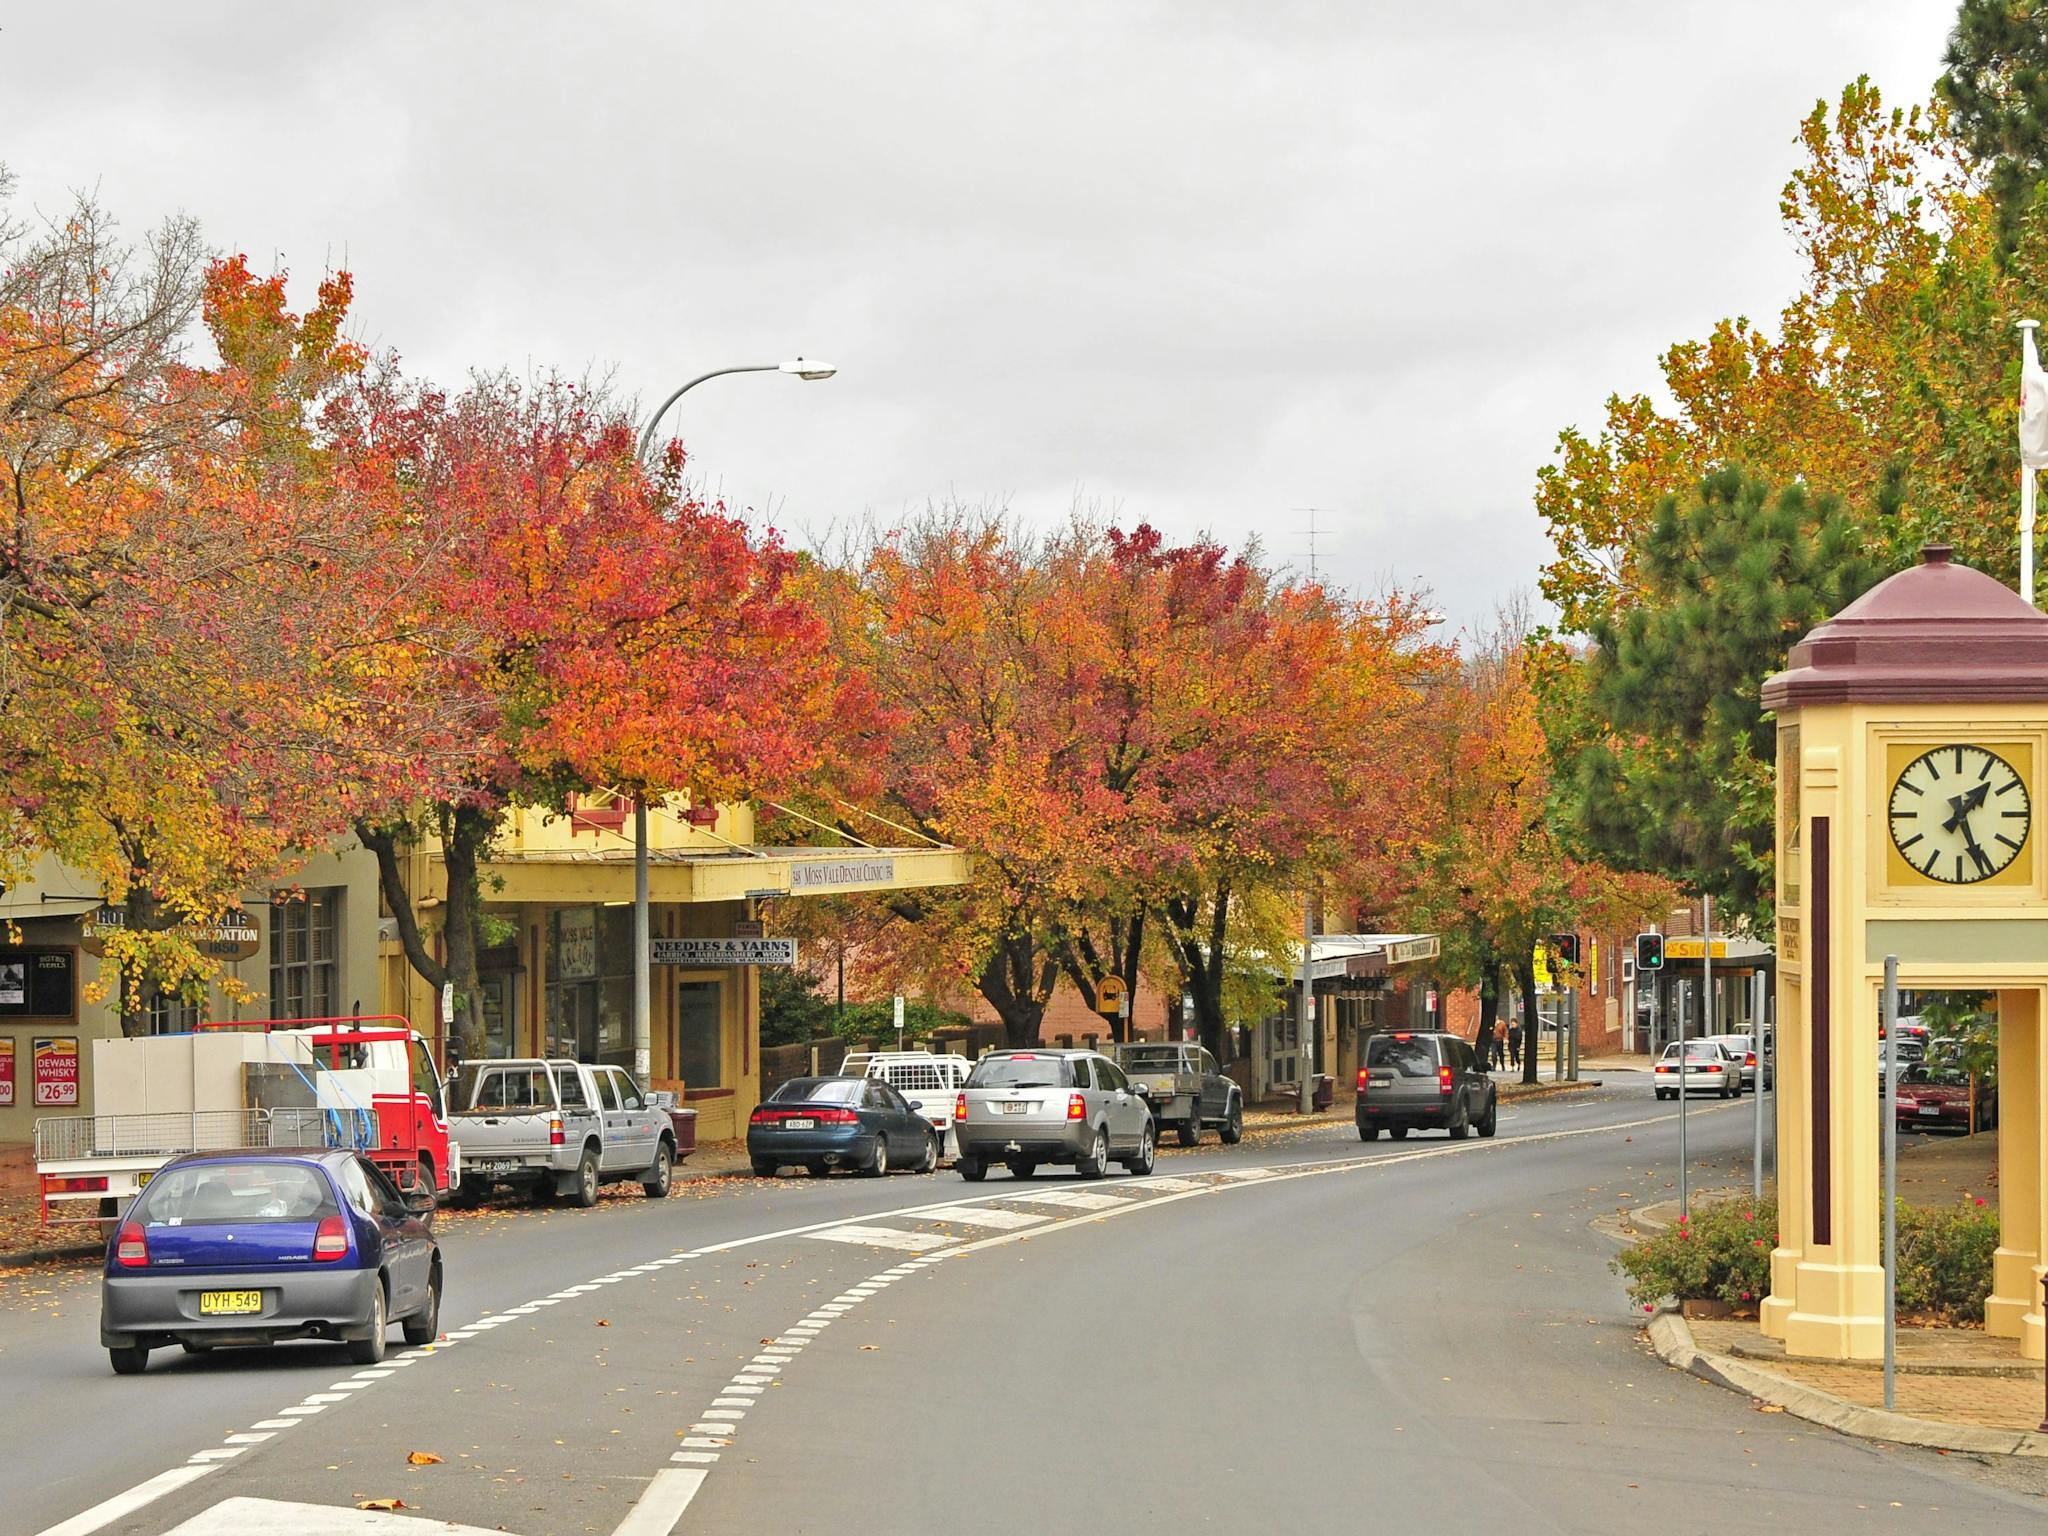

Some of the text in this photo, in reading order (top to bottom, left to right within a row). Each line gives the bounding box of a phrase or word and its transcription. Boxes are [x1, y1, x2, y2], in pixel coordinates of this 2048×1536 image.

[655, 941, 790, 951] NEEDLES & YARNS
[37, 1058, 77, 1068] DEWARS
[39, 1068, 76, 1077] WHISKY
[40, 1084, 75, 1099] $26.99
